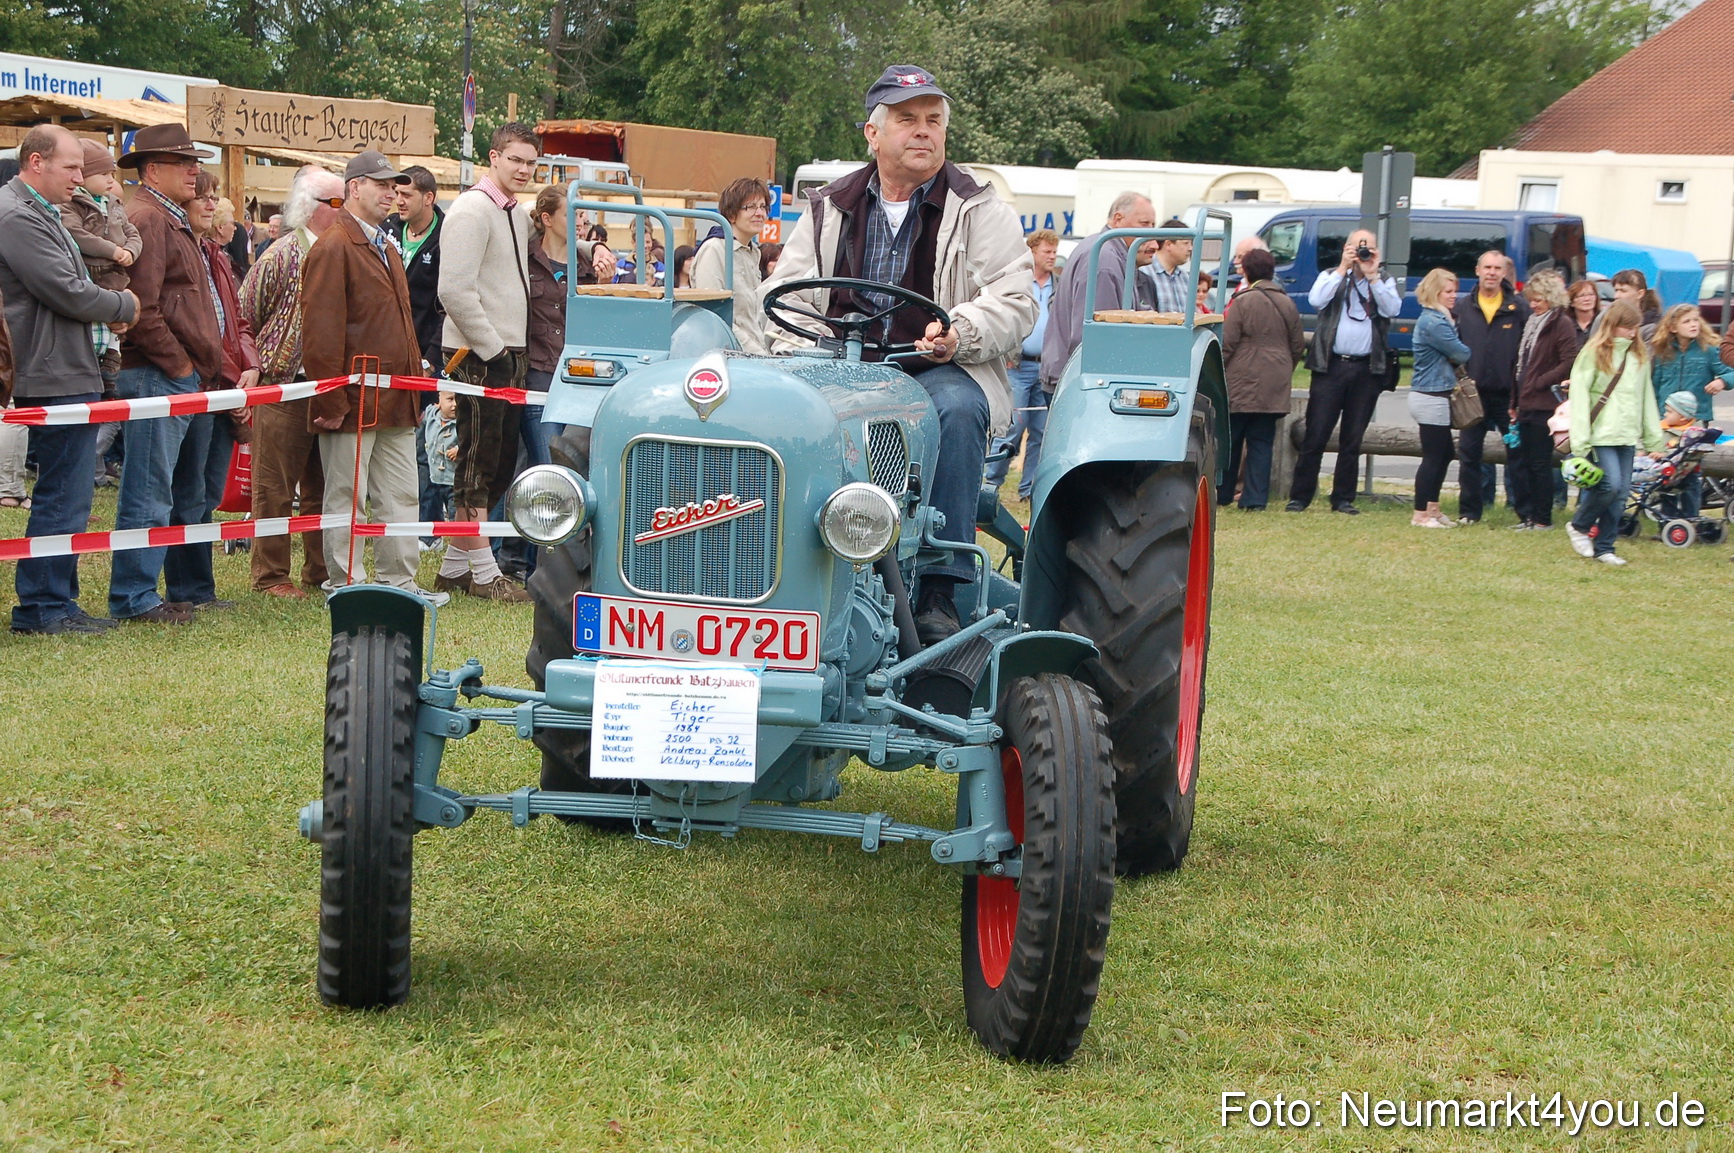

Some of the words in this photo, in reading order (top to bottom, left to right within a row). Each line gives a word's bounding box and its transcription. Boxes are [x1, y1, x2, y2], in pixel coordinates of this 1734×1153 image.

[25, 67, 102, 99] Internet!
[235, 98, 315, 144] Staufer
[316, 104, 410, 150] Bergesel
[762, 223, 778, 240] P2
[651, 494, 741, 532] Eicher
[583, 627, 594, 641] D
[609, 605, 665, 651] NM
[696, 614, 809, 661] 0720
[690, 674, 755, 690] Batzhausen
[670, 699, 716, 712] Eicher
[671, 712, 714, 725] Tiger
[675, 723, 700, 733] 1964
[665, 733, 692, 744] 2500
[727, 735, 740, 746] 32
[663, 744, 708, 756] Andreas
